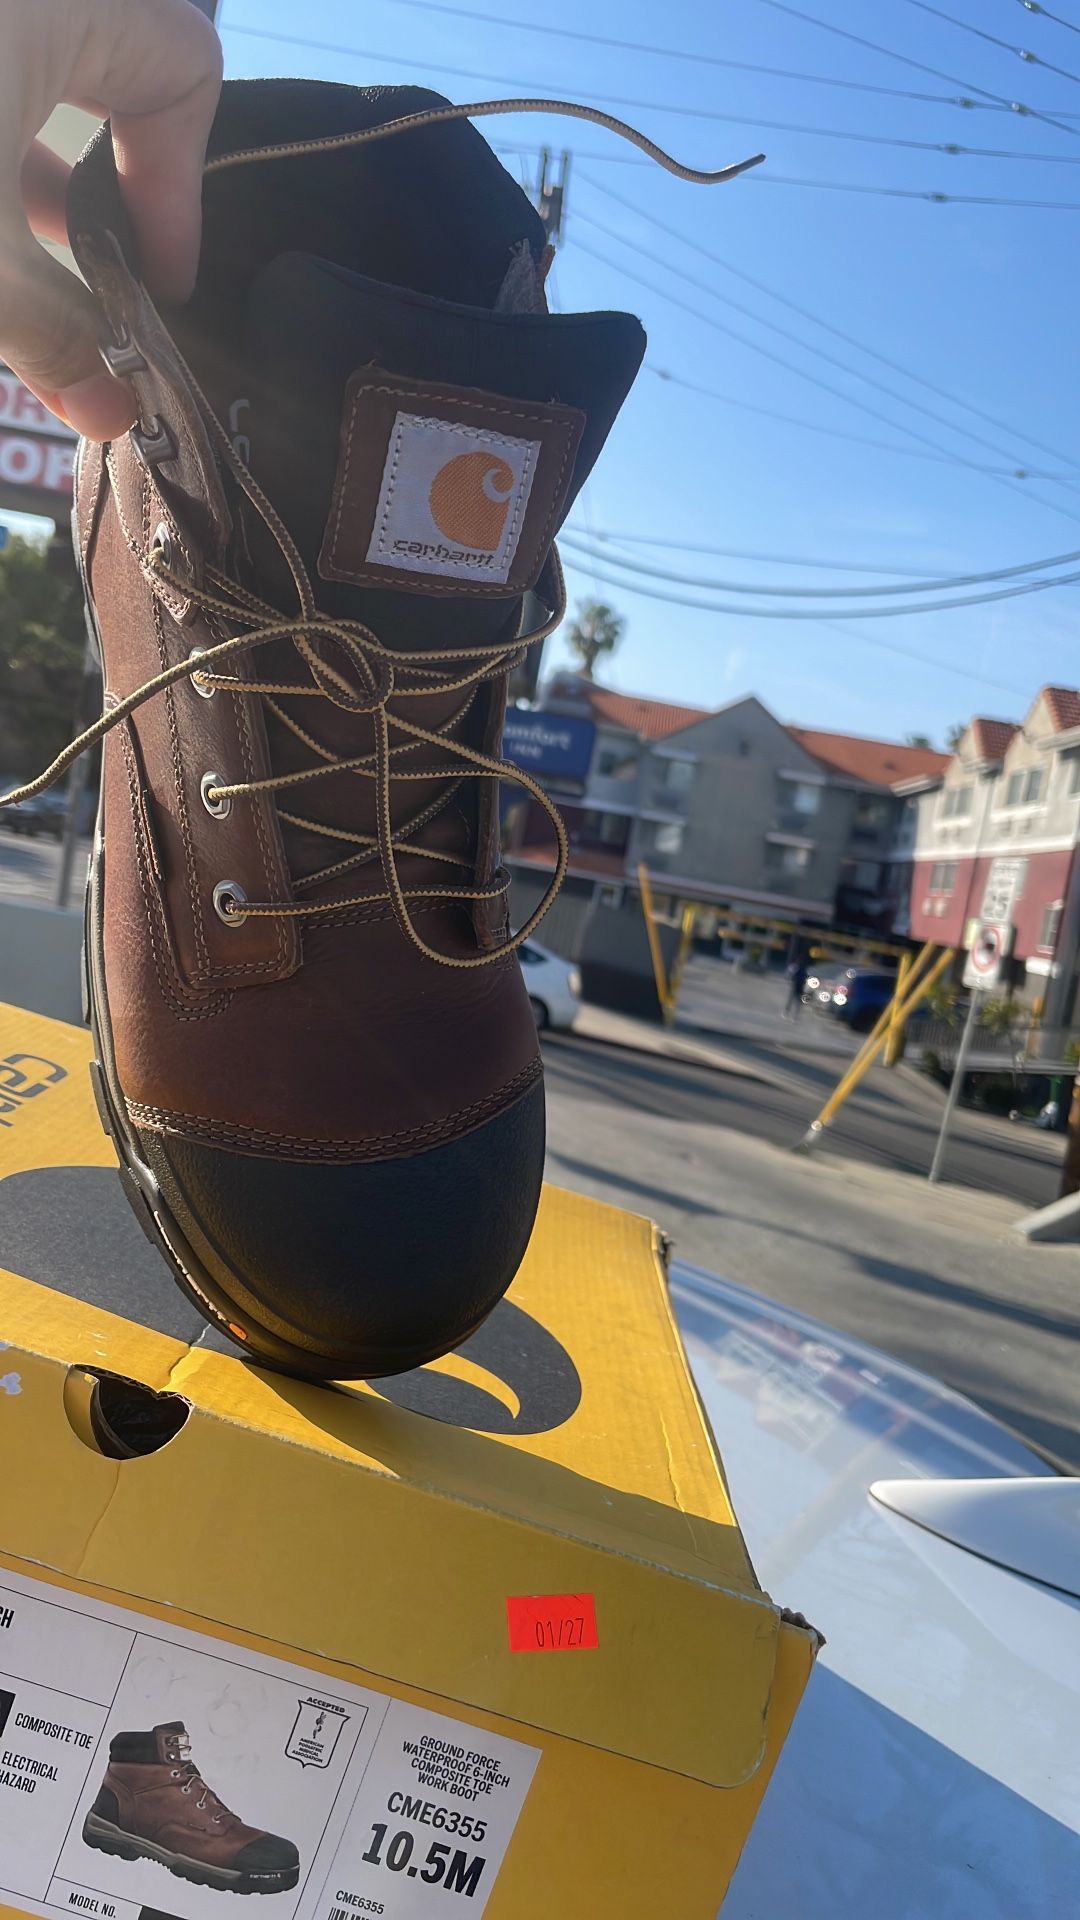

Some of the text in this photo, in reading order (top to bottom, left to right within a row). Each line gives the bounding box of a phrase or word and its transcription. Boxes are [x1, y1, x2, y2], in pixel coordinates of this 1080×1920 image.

[393, 540, 495, 565] carhartt
[503, 723, 571, 751] omfort
[536, 1618, 584, 1647] 01/27
[306, 1697, 345, 1713] ACCEPTED
[15, 1712, 94, 1749] COMPOSITE TOE
[1, 1751, 58, 1781] ELECTRICAL
[402, 1741, 511, 1788] WATERPROOF 6-INCH
[420, 1735, 501, 1772] GROUND FORCE
[411, 1757, 494, 1795] COMPOSITE TOE
[417, 1772, 480, 1802] WORK BOOT
[387, 1791, 488, 1842] CME6355
[361, 1823, 487, 1898] 10.5M
[68, 1892, 116, 1918] MODEL NO.
[335, 1890, 385, 1915] CME6355
